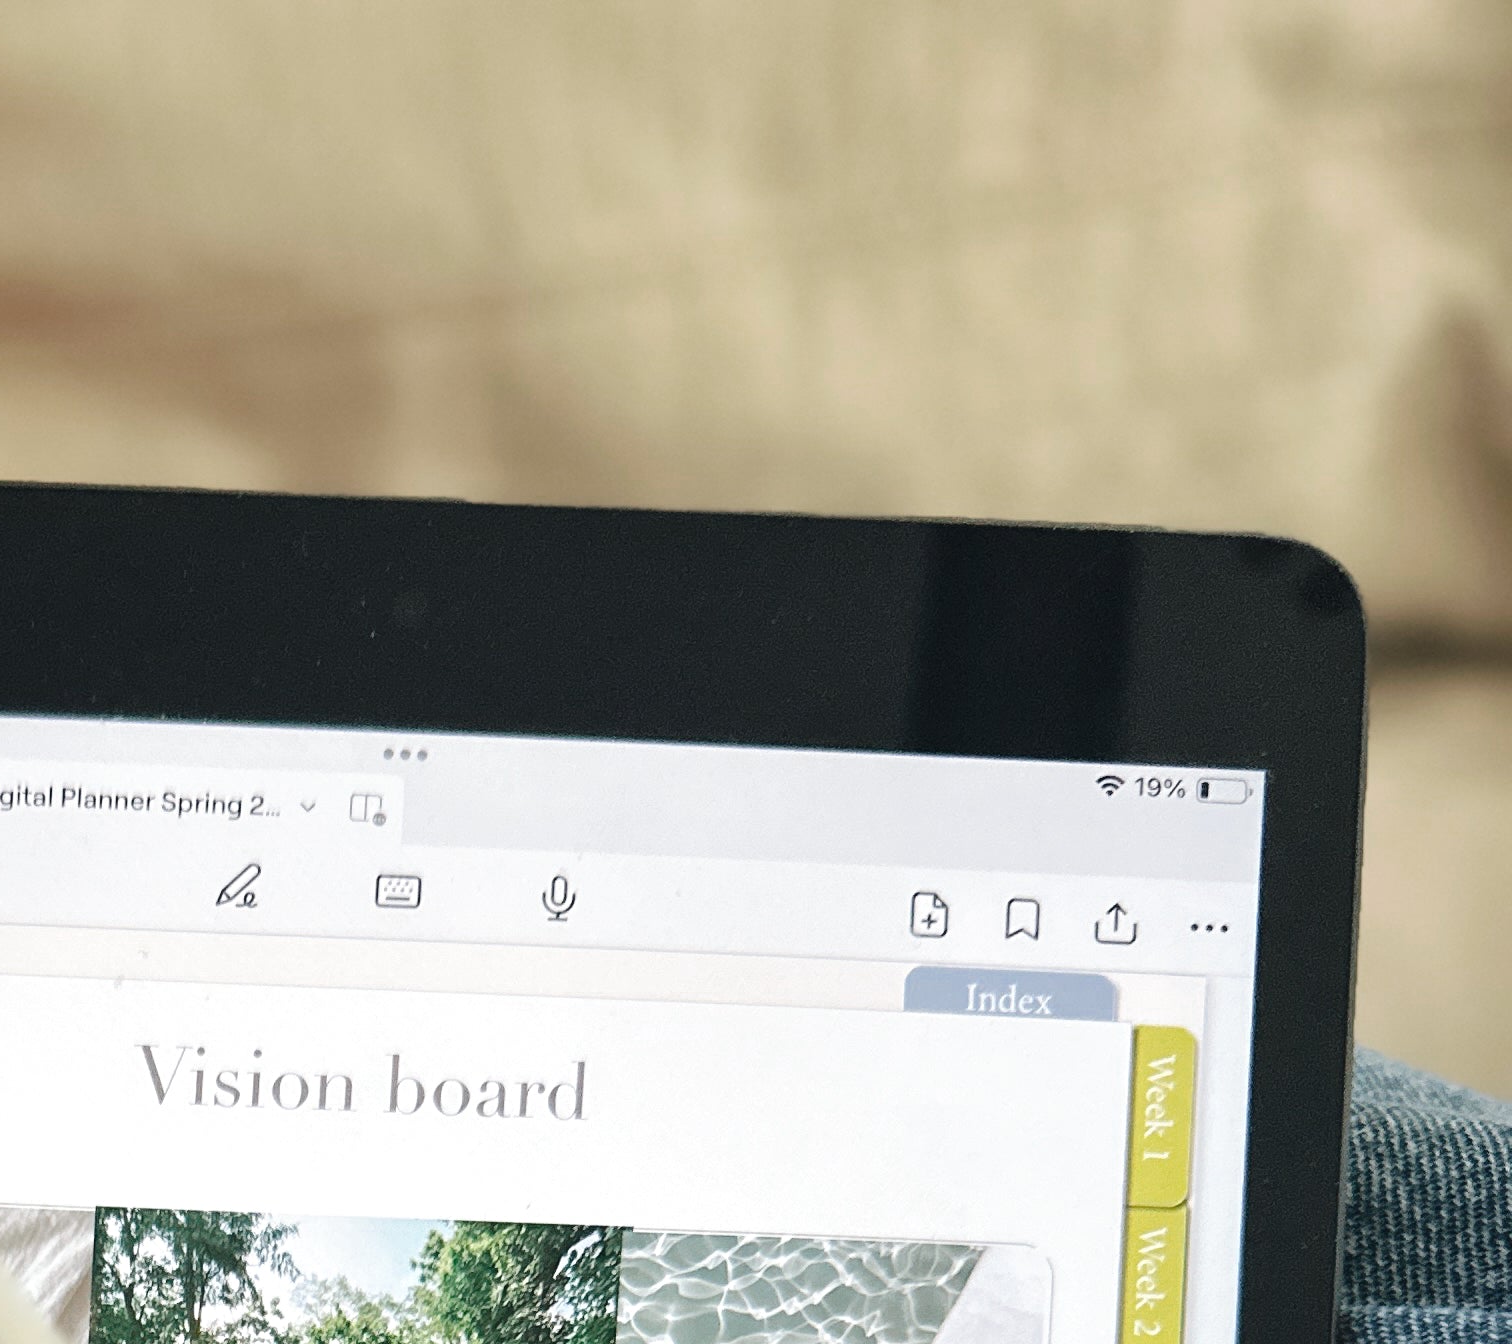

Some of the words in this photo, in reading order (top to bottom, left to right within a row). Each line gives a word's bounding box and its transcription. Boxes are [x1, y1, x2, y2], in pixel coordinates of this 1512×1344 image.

[61, 785, 155, 812] Planner
[161, 791, 242, 821] Spring
[1135, 777, 1186, 799] 19%
[966, 983, 1053, 1015] Index
[134, 1043, 356, 1113] Vision
[383, 1053, 589, 1121] board
[1143, 1054, 1177, 1138] Week
[1142, 1150, 1170, 1161] 1
[1135, 1226, 1168, 1311] Week
[1133, 1319, 1161, 1338] 2
